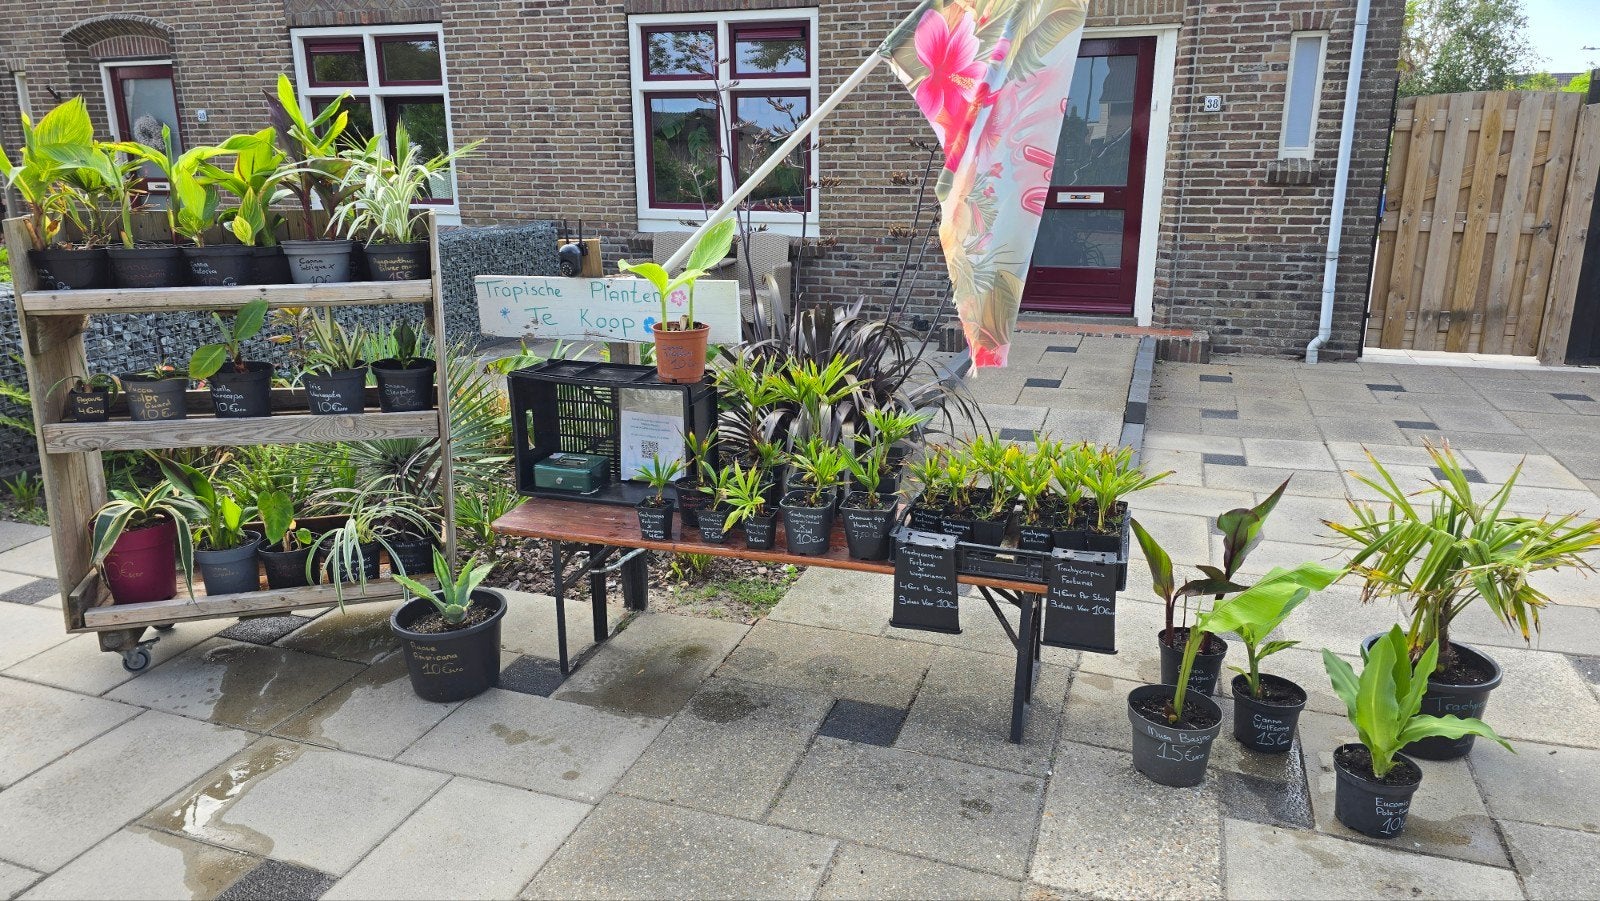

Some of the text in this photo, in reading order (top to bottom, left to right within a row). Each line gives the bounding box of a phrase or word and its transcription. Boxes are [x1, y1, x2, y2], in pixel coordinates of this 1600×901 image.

[1207, 98, 1219, 109] 38
[477, 281, 662, 304] Tropische Planten
[524, 306, 635, 337] Te Koop
[1054, 563, 1105, 578] Trachycarpus
[1253, 713, 1283, 724] Canna
[1147, 725, 1172, 742] Musa
